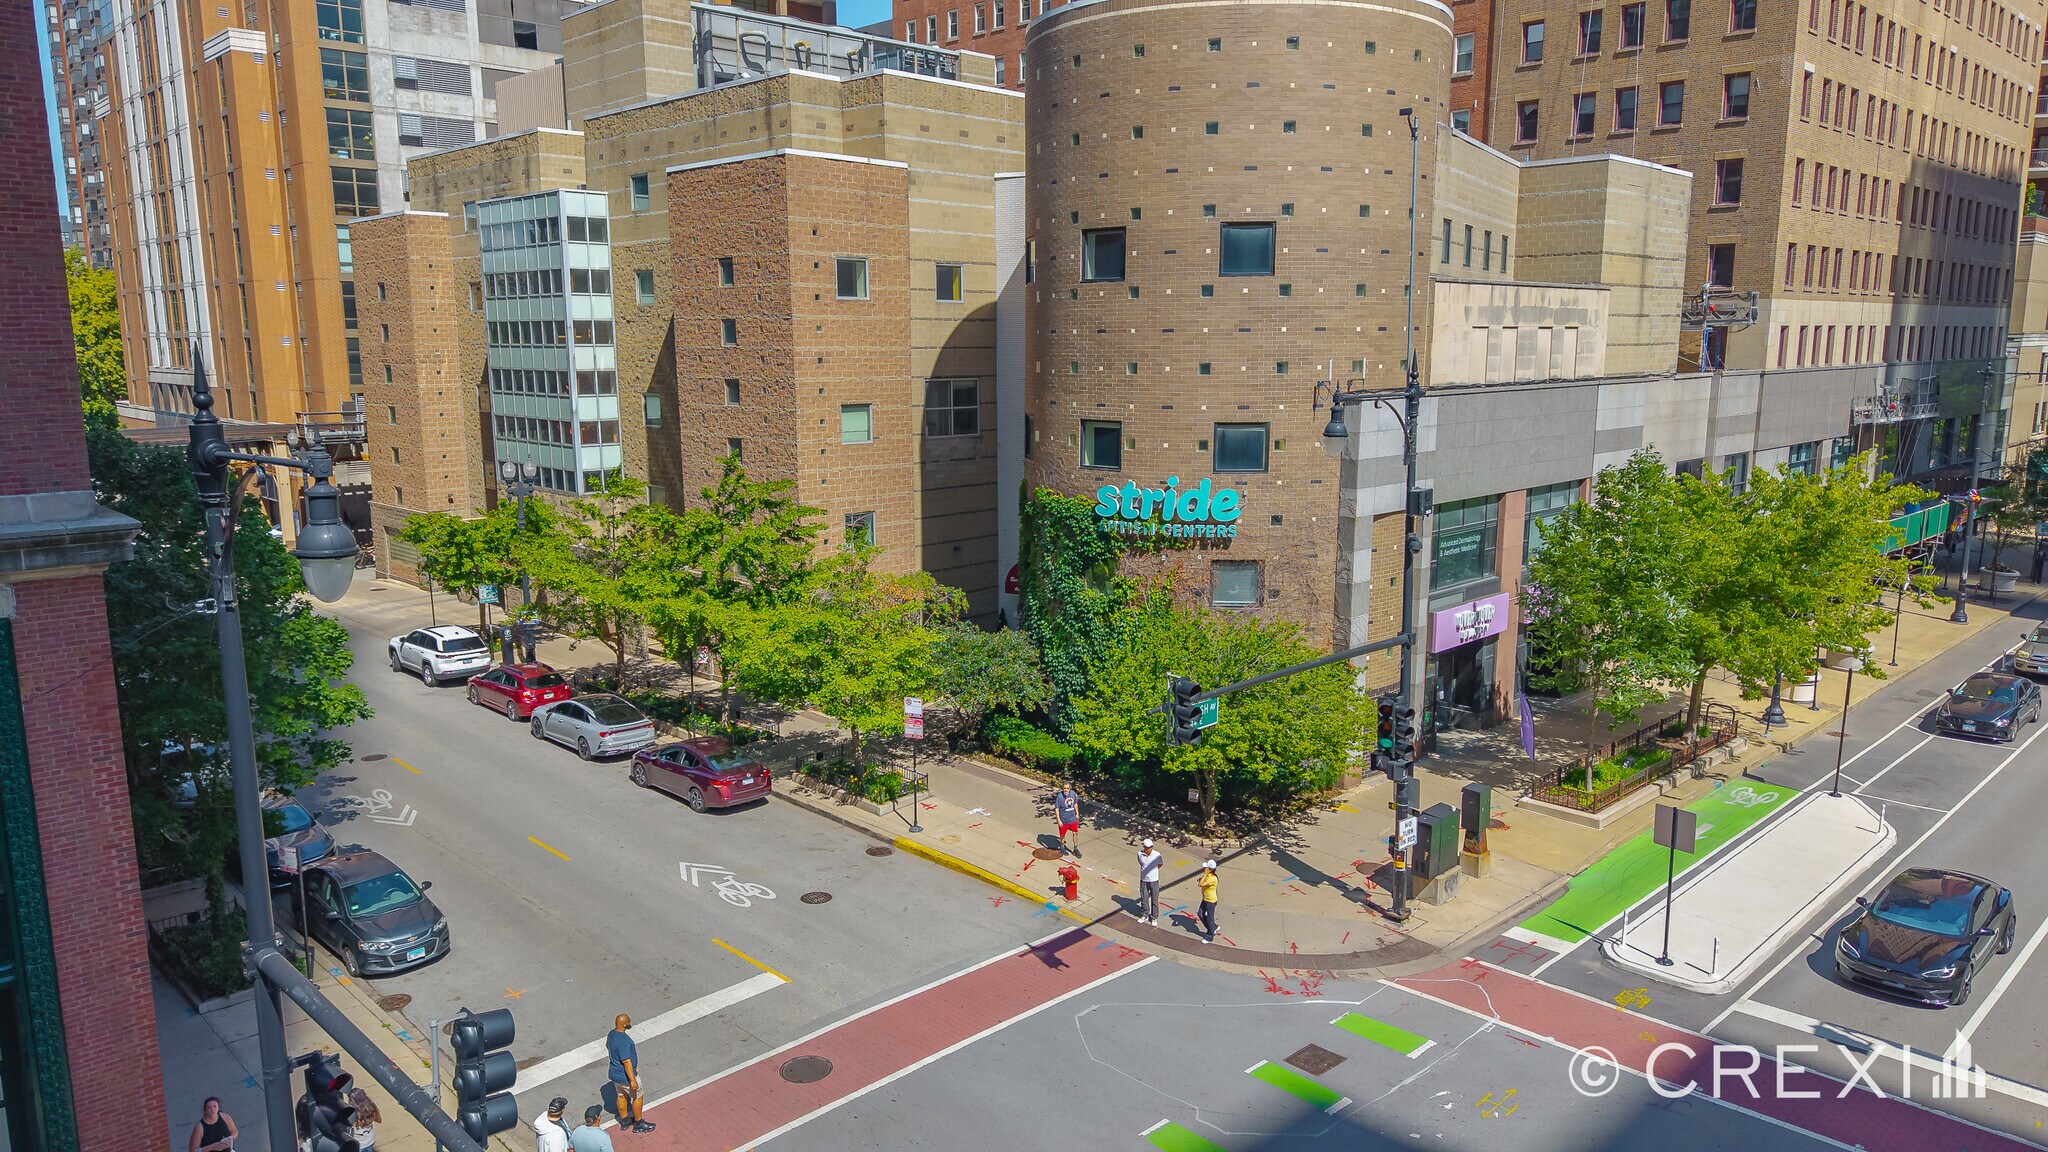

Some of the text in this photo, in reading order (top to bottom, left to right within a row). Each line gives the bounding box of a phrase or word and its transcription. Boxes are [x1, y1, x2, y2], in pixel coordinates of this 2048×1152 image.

[1095, 476, 1241, 521] stride
[1161, 523, 1238, 539] CENTERS
[1440, 534, 1481, 548] Advanced Dermatology
[1402, 829, 1414, 837] TURN
[1407, 834, 1416, 842] RED
